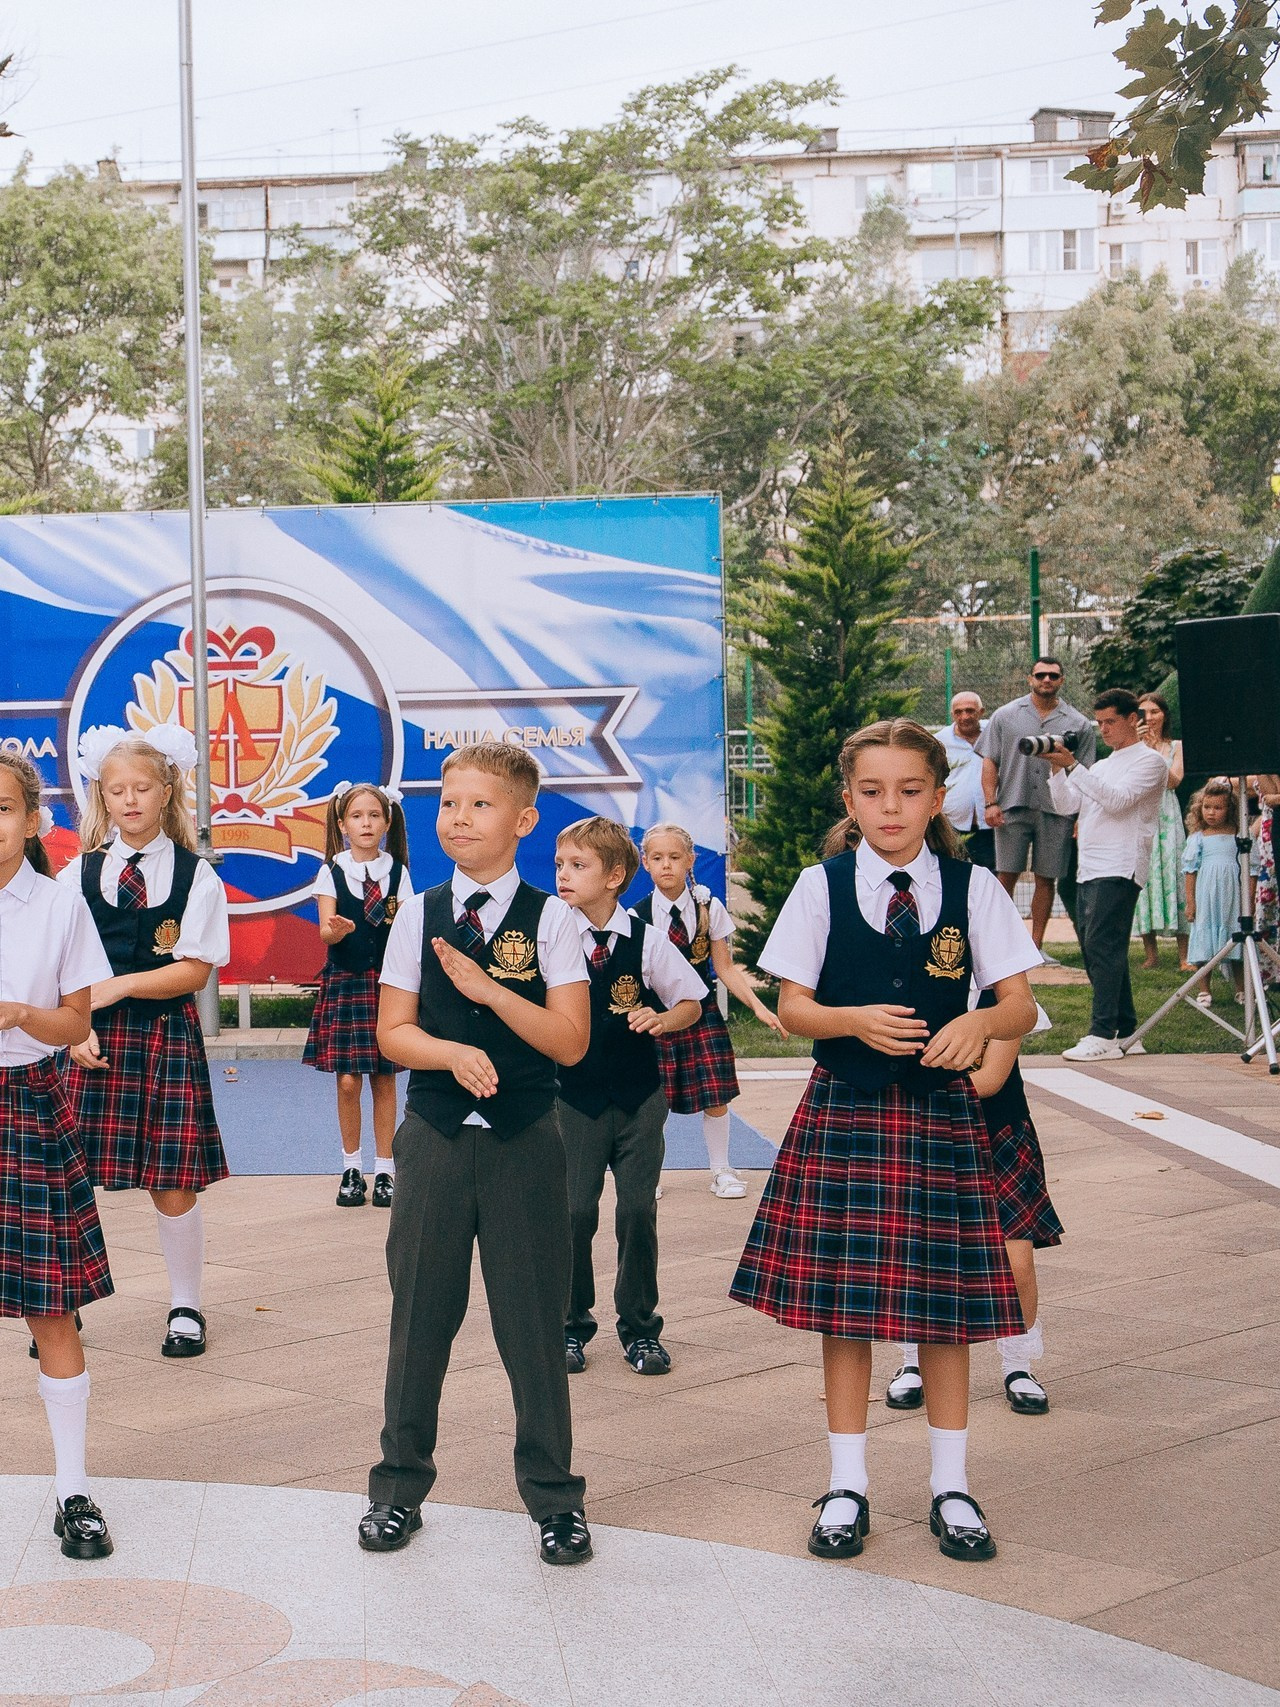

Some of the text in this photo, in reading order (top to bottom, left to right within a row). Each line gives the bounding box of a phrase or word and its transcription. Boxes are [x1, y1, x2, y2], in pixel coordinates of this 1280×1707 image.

[424, 726, 586, 749] НАША СЕМЬЯ
[222, 829, 250, 841] 1998
